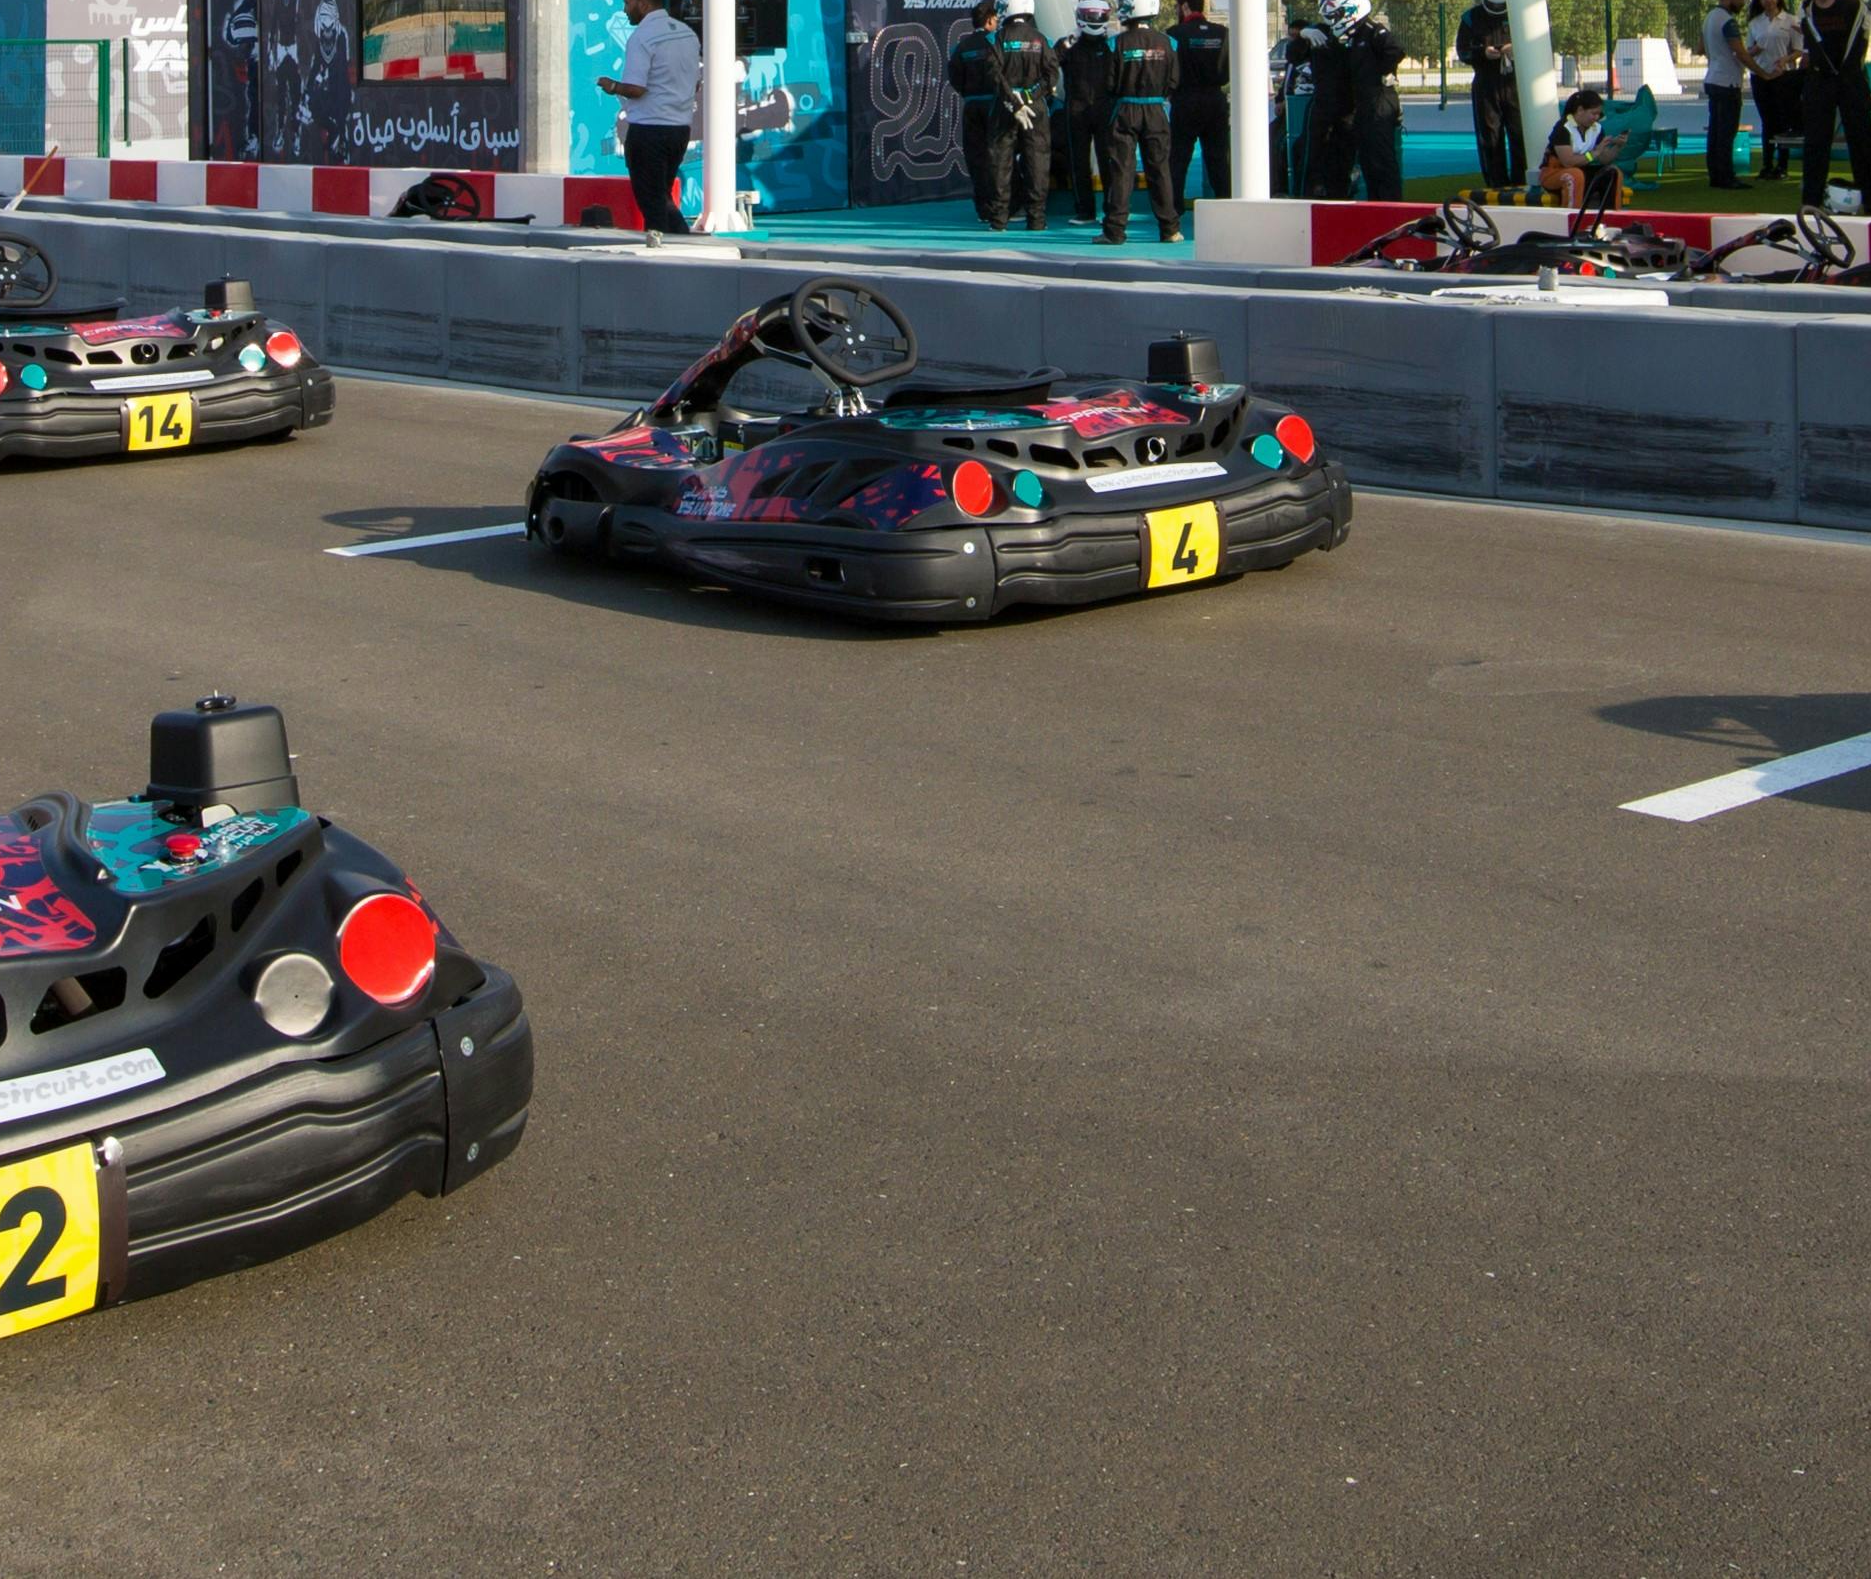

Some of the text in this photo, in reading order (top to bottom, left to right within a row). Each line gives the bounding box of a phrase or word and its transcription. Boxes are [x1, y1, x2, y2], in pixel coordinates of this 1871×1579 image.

[133, 40, 188, 72] YA
[139, 403, 184, 443] 14
[1172, 522, 1198, 574] 4
